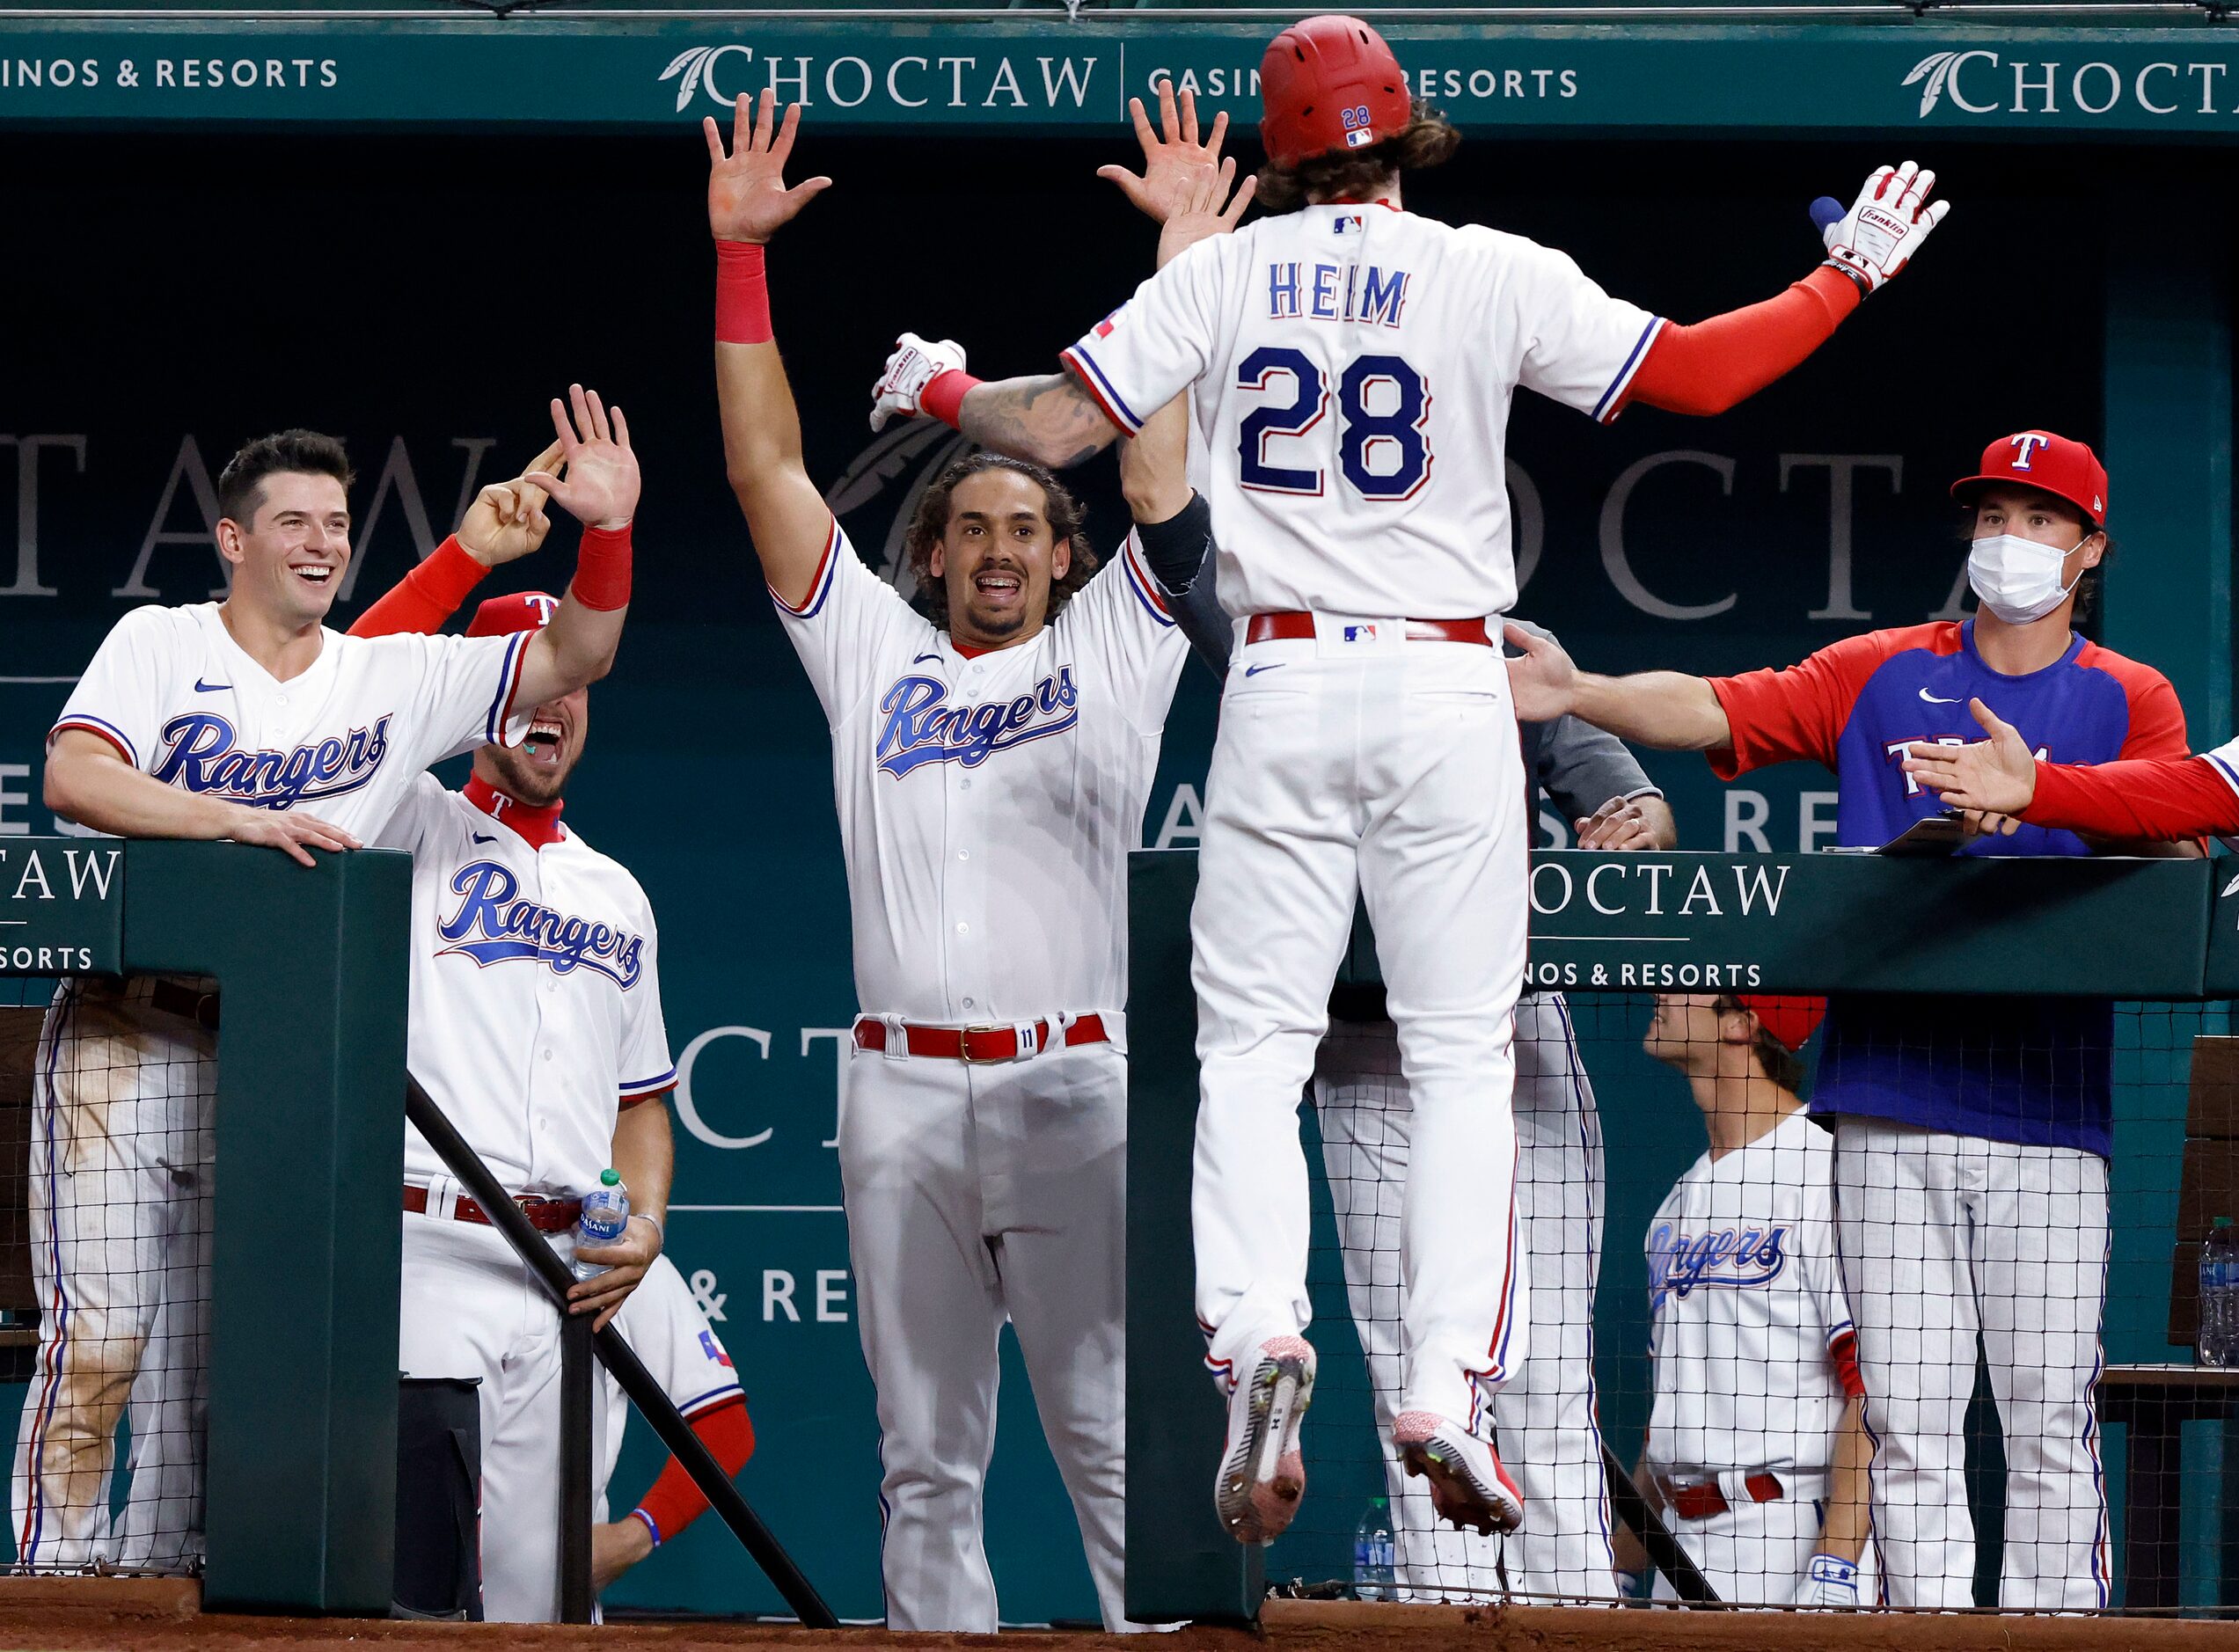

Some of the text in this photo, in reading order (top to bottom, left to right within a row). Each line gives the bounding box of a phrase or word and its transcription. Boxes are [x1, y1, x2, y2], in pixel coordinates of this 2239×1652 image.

[3, 59, 337, 87] INOS & RESORTS
[703, 45, 1097, 107] CHOCTAW
[1947, 50, 2239, 114] CHOCT
[1342, 106, 1371, 129] 28
[1267, 262, 1411, 328] HEIM
[1236, 347, 1434, 501] 28
[874, 664, 1078, 781] Rangers
[150, 711, 393, 813] Rangers
[434, 859, 645, 991] Rangers
[1591, 963, 1608, 985] &
[1621, 963, 1760, 986] RESORTS
[1021, 1028, 1032, 1048] 11
[581, 1213, 610, 1232] DASANI
